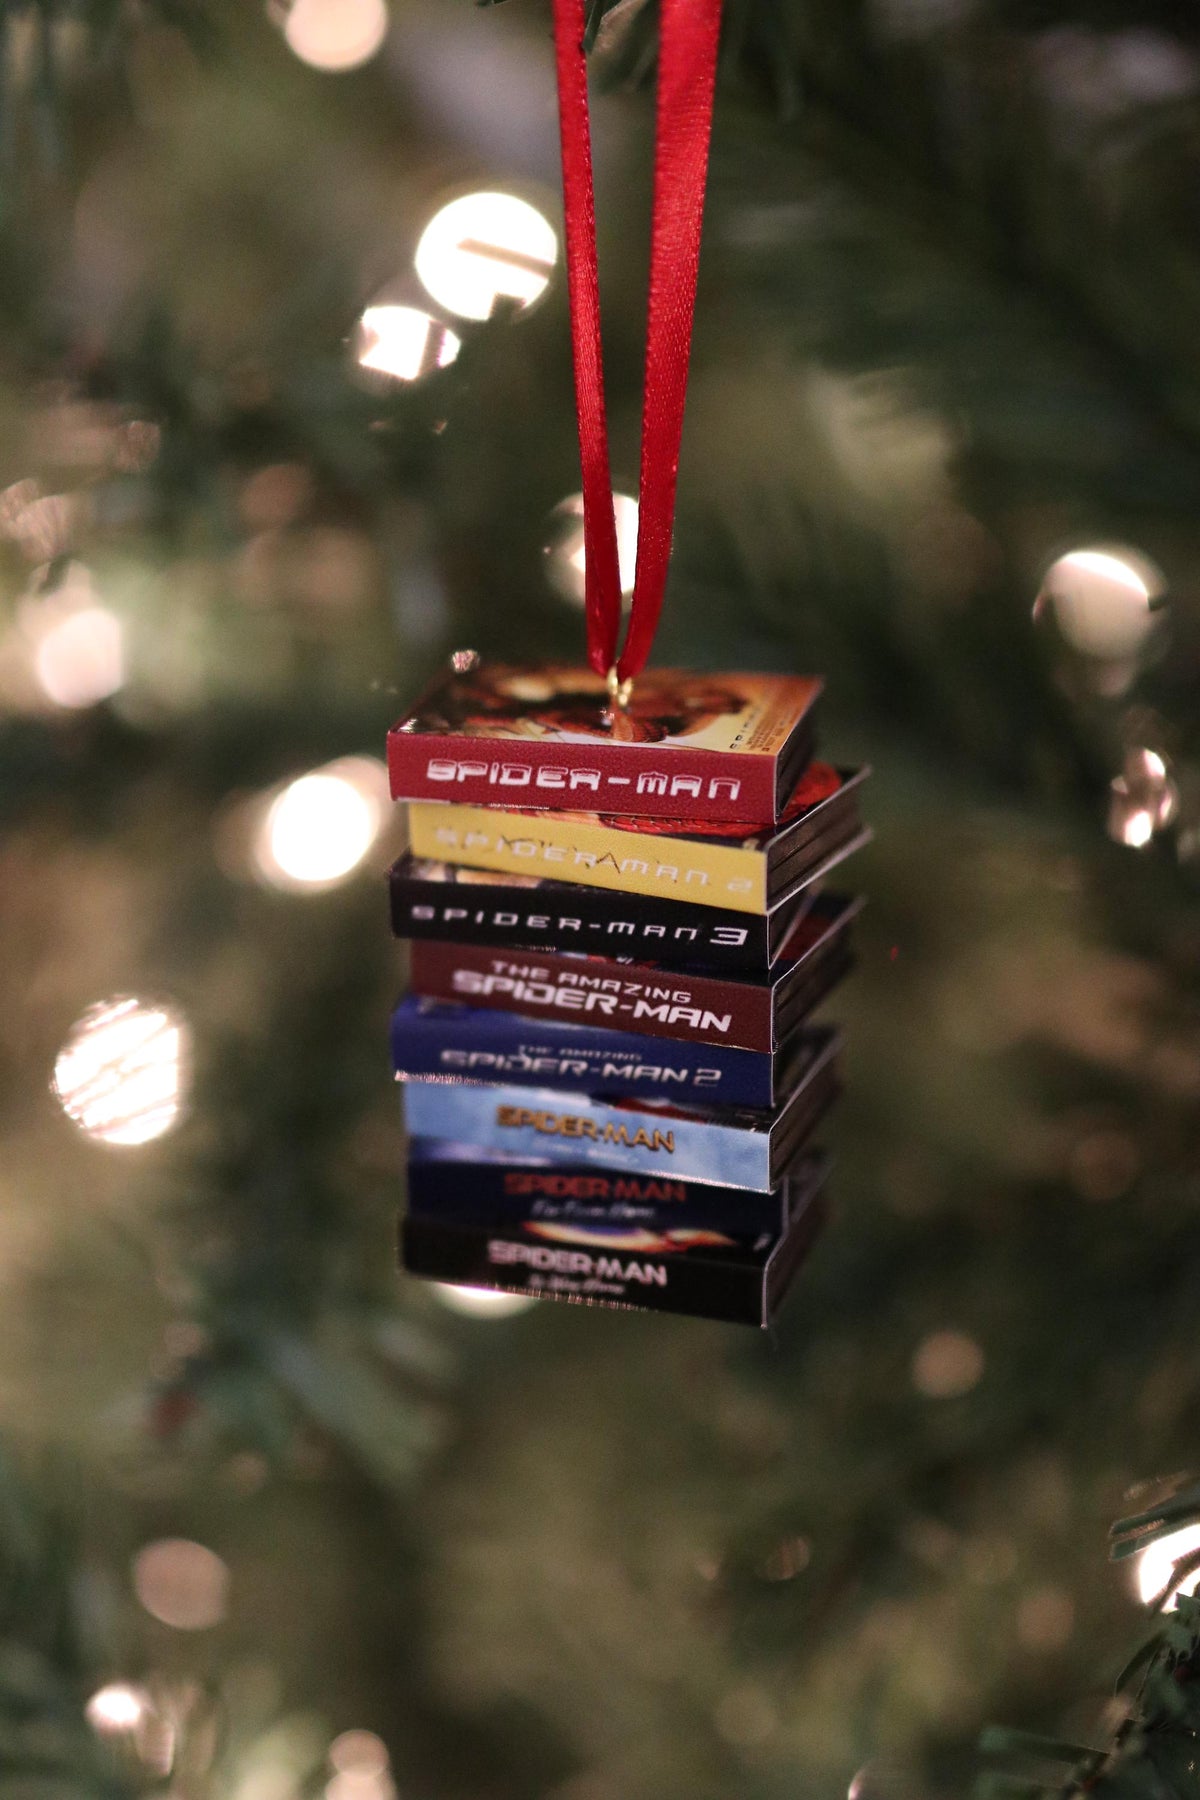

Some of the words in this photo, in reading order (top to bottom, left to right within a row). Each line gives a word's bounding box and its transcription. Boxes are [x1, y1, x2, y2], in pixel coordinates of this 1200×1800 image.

[427, 758, 741, 801] SPIDER-MAN
[411, 905, 699, 941] SPIDER-MAN
[709, 926, 749, 946] 3
[452, 969, 732, 1032] SPIDER-MAN
[491, 960, 550, 980] THE
[558, 972, 692, 1003] AMAZING
[440, 1049, 688, 1083] SPIDER-MAN
[692, 1068, 722, 1088] 2
